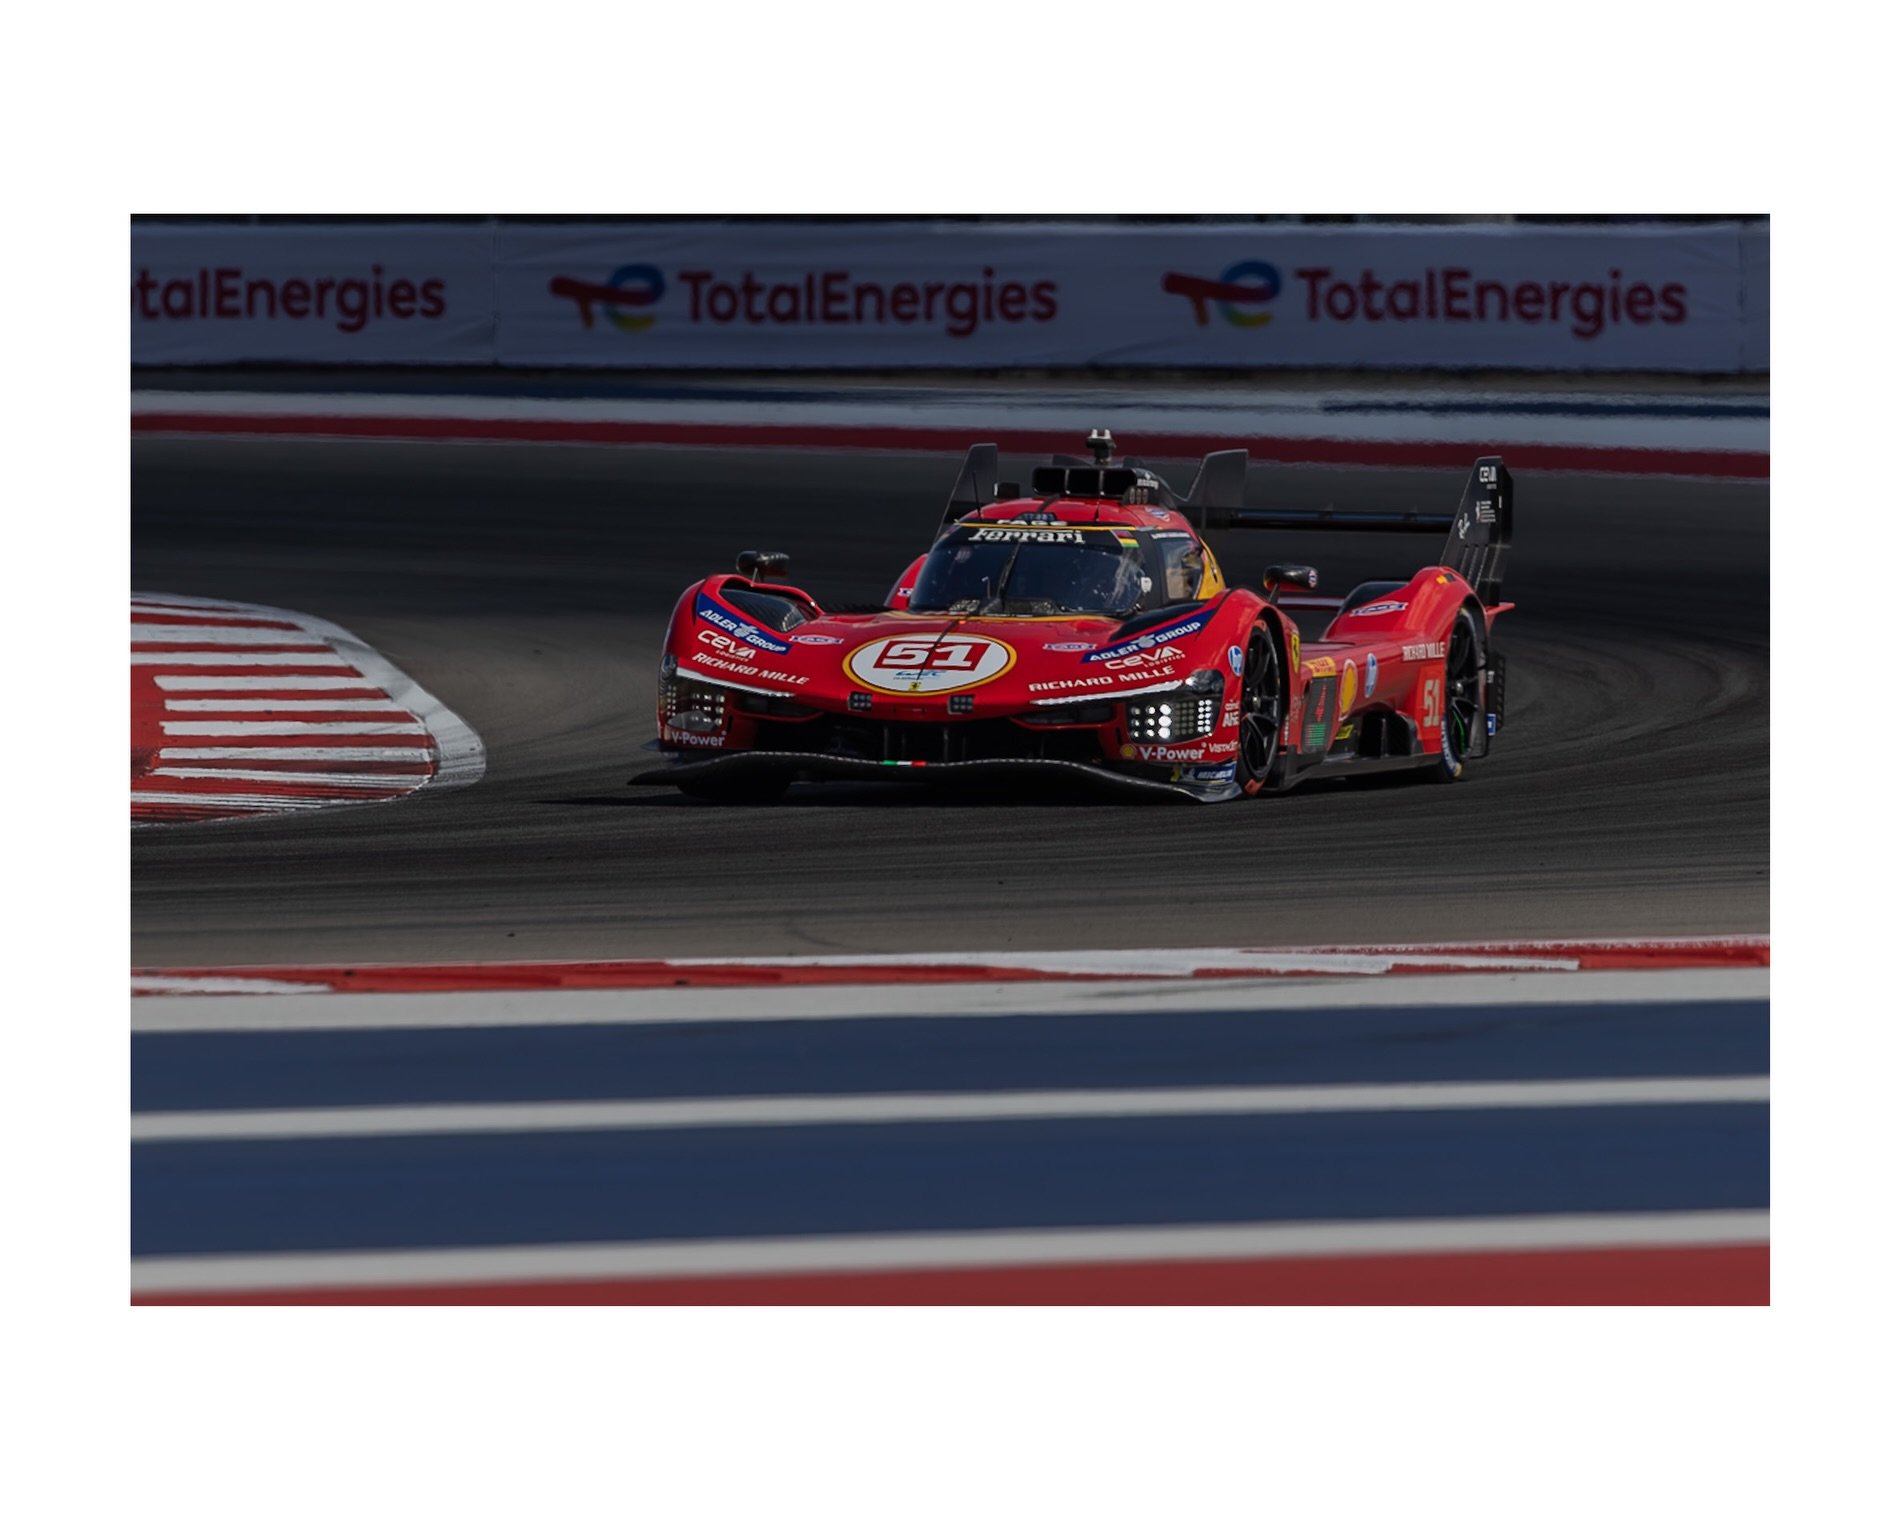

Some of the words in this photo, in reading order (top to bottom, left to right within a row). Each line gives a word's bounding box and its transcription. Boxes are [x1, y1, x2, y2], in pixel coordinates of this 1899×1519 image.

[131, 264, 447, 332] talEnergies
[679, 266, 1058, 337] TotalEnergies
[1297, 263, 1687, 339] TotalEnergies
[968, 526, 1086, 544] Ferrari
[699, 609, 738, 632] ADLER
[745, 634, 788, 653] GROUP
[1089, 644, 1140, 662] ADLER
[1154, 620, 1202, 644] GROUP
[692, 652, 760, 677] RICHARD
[758, 669, 811, 686] MILLE
[881, 643, 975, 668] 51
[1028, 676, 1114, 693] RICHARD
[1118, 664, 1176, 683] MILLE
[1423, 679, 1441, 727] 51
[672, 731, 725, 747] V-Power
[1138, 745, 1205, 760] V-Power
